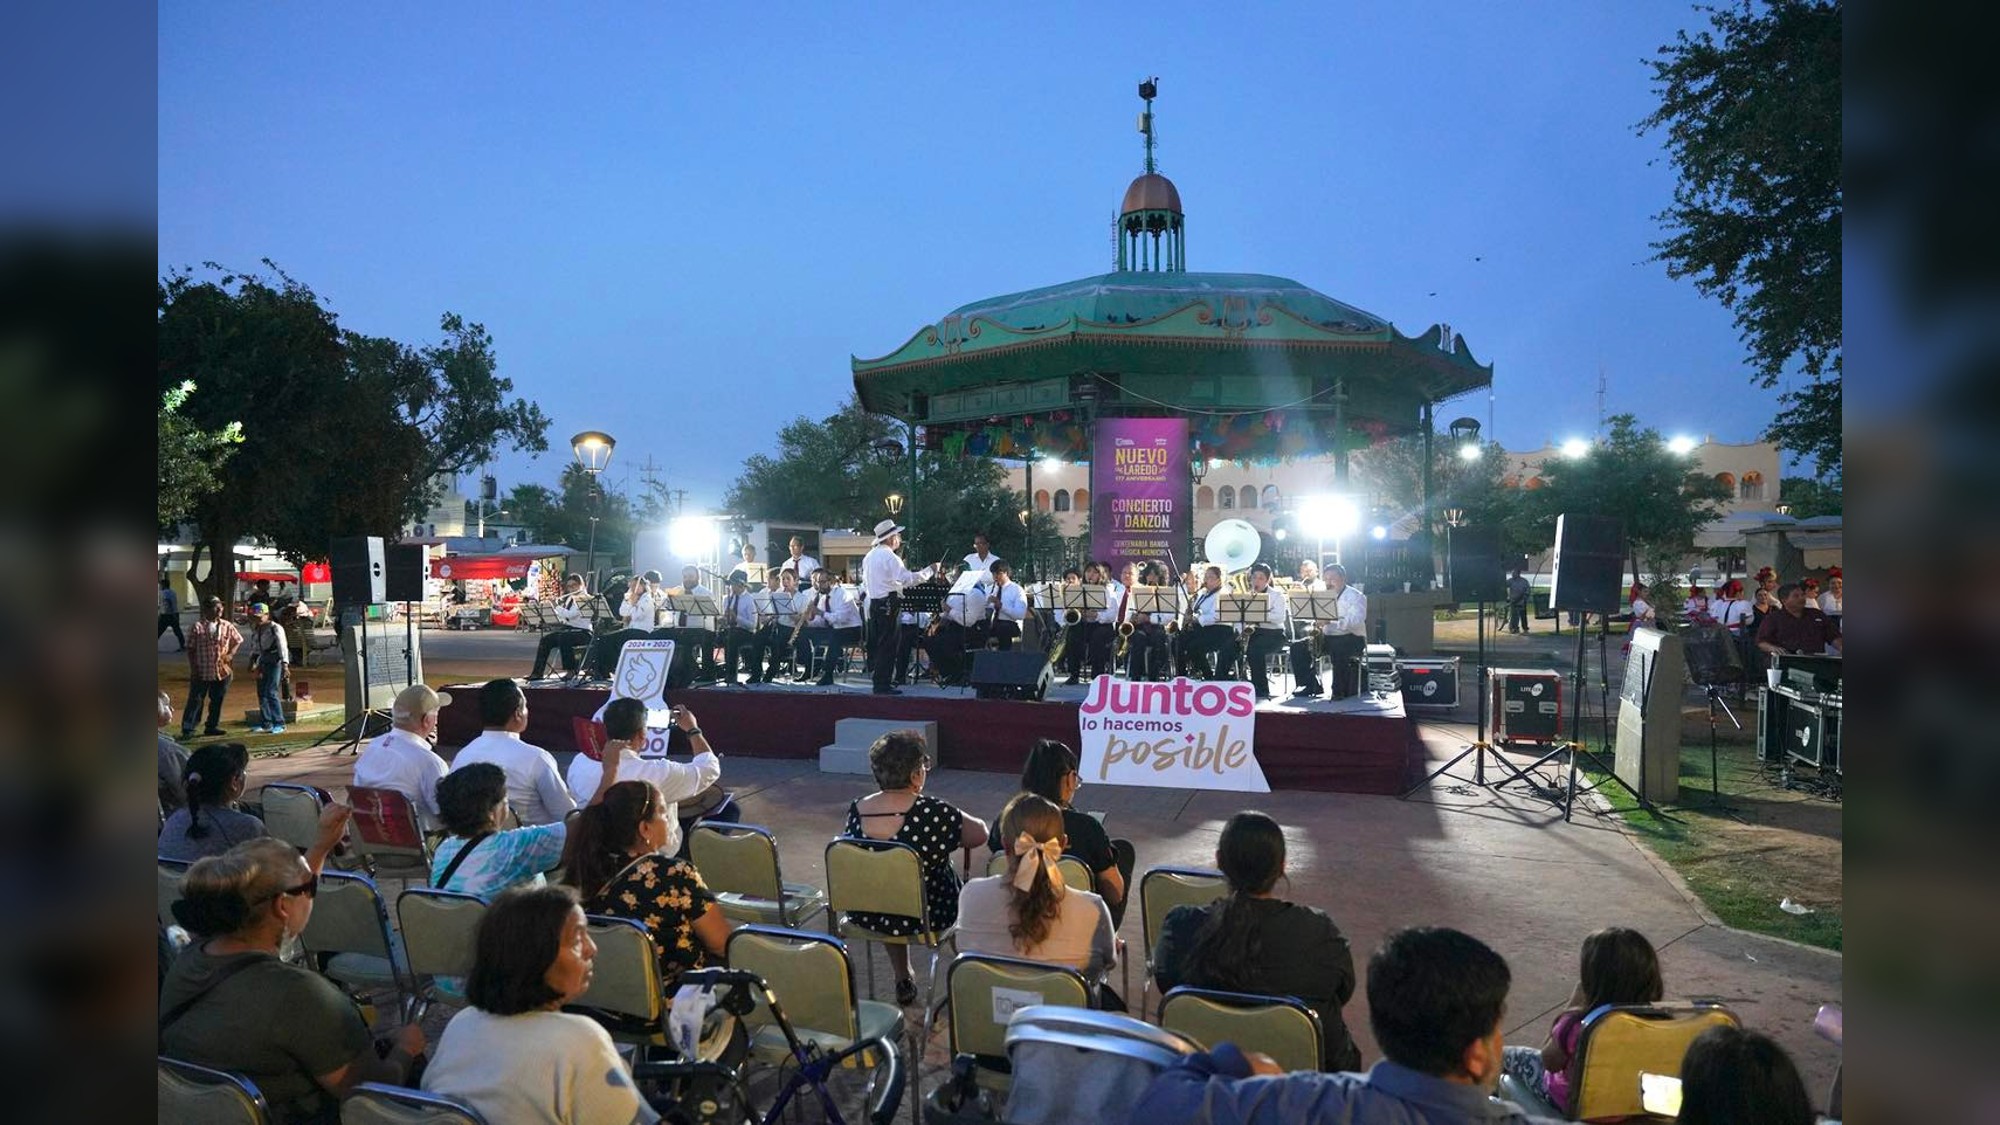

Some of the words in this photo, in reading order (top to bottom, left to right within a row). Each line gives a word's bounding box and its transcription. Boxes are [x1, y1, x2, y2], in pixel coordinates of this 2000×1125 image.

[1115, 448, 1167, 465] NUEVO
[1124, 464, 1158, 475] LAREDO
[1112, 499, 1172, 512] CONCIERTO
[1114, 514, 1121, 528] Y
[1125, 512, 1170, 528] DANZÓN
[1081, 676, 1253, 717] Juntos
[1082, 717, 1097, 731] lo
[1103, 717, 1183, 732] hacemos
[1100, 725, 1247, 780] posible
